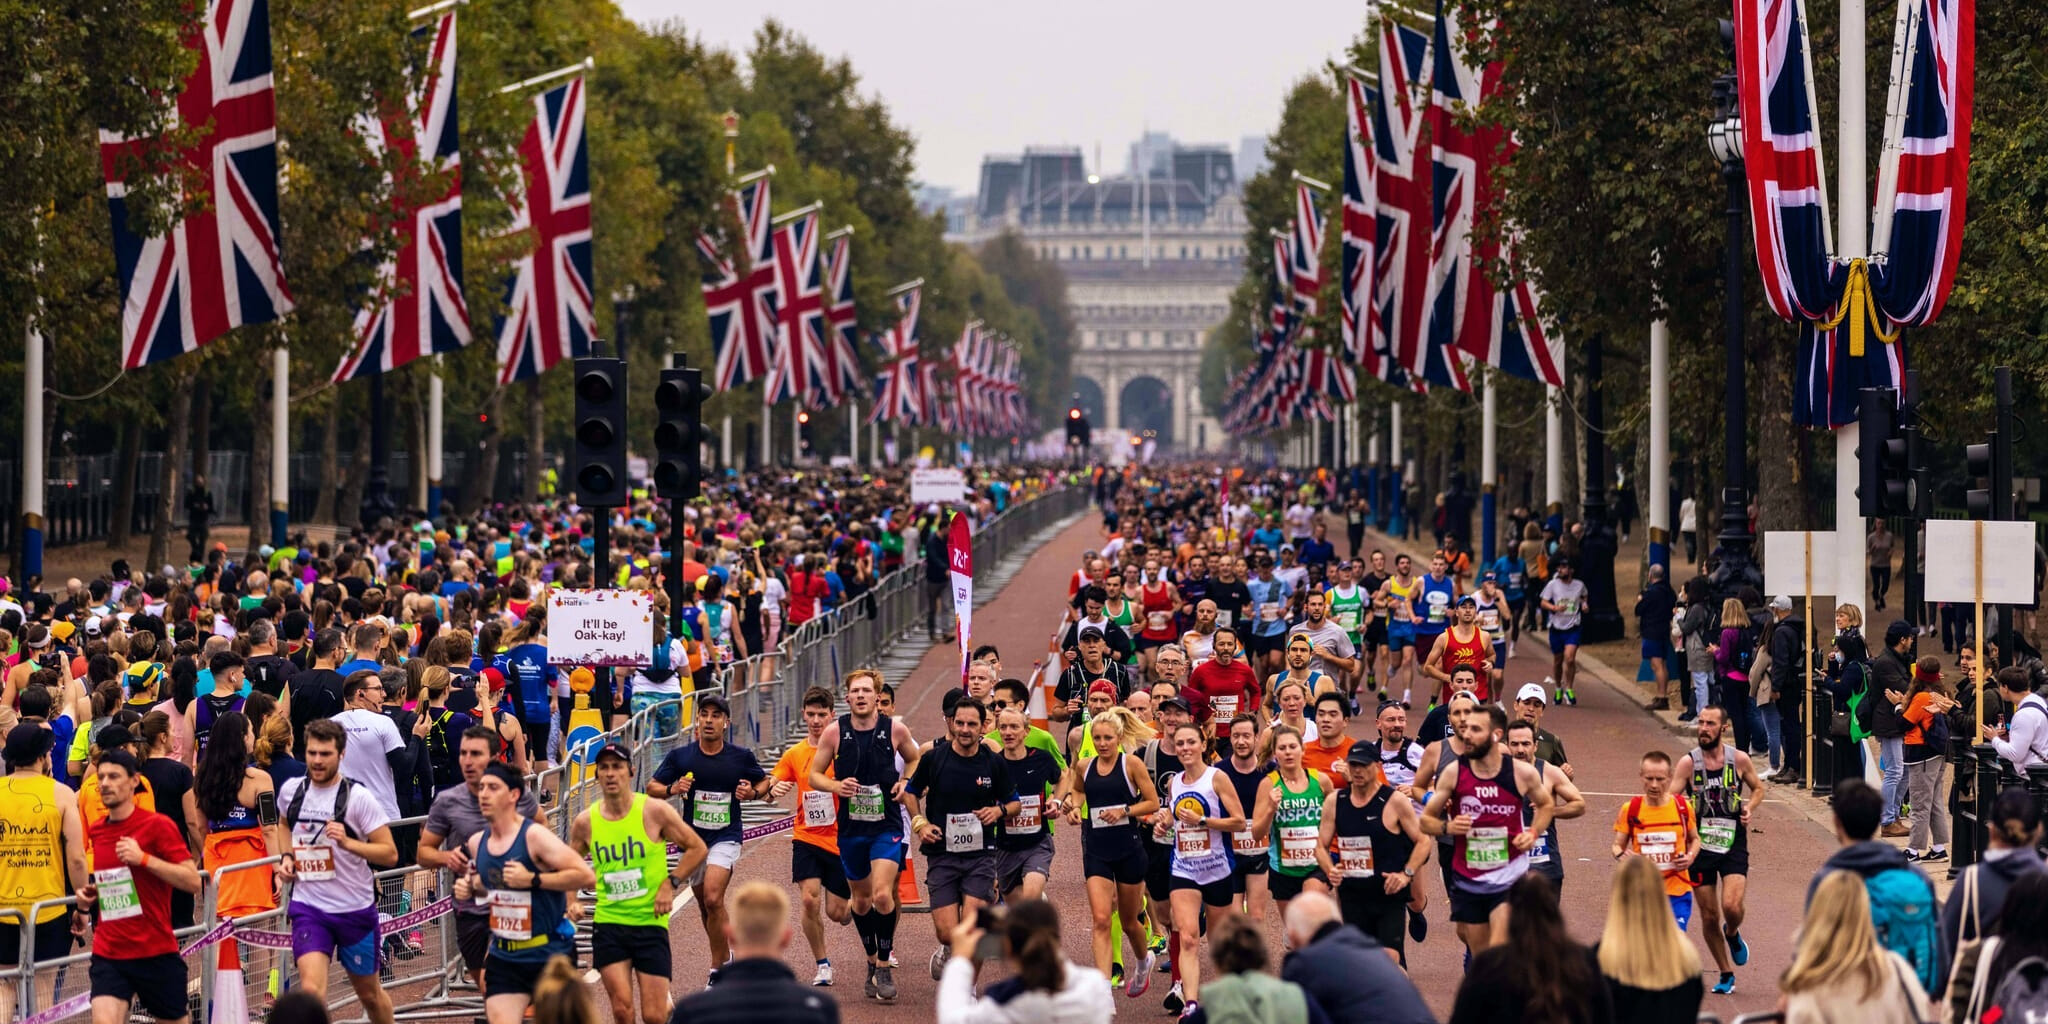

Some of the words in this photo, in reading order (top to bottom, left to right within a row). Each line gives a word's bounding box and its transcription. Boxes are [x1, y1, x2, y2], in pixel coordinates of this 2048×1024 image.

[583, 619, 600, 629] It'll
[603, 619, 618, 629] be
[574, 630, 626, 643] Oak-kay!
[1474, 786, 1499, 798] TOM
[1277, 796, 1321, 810] KENDAL
[854, 805, 880, 814] 2928
[1275, 807, 1323, 823] NSPCC
[1461, 804, 1516, 816] mencap
[228, 811, 246, 820] cap
[700, 811, 725, 822] 4453
[808, 810, 826, 824] 831
[1012, 816, 1034, 827] 1271
[953, 834, 973, 844] 200
[595, 836, 646, 867] hyh
[1182, 841, 1204, 851] 1482
[0, 848, 32, 857] ambeth
[36, 848, 51, 856] and
[1289, 849, 1315, 859] 1532
[7, 859, 51, 868] Southwark
[301, 860, 326, 872] 1013
[610, 879, 639, 894] 3938
[497, 917, 522, 930] 1074
